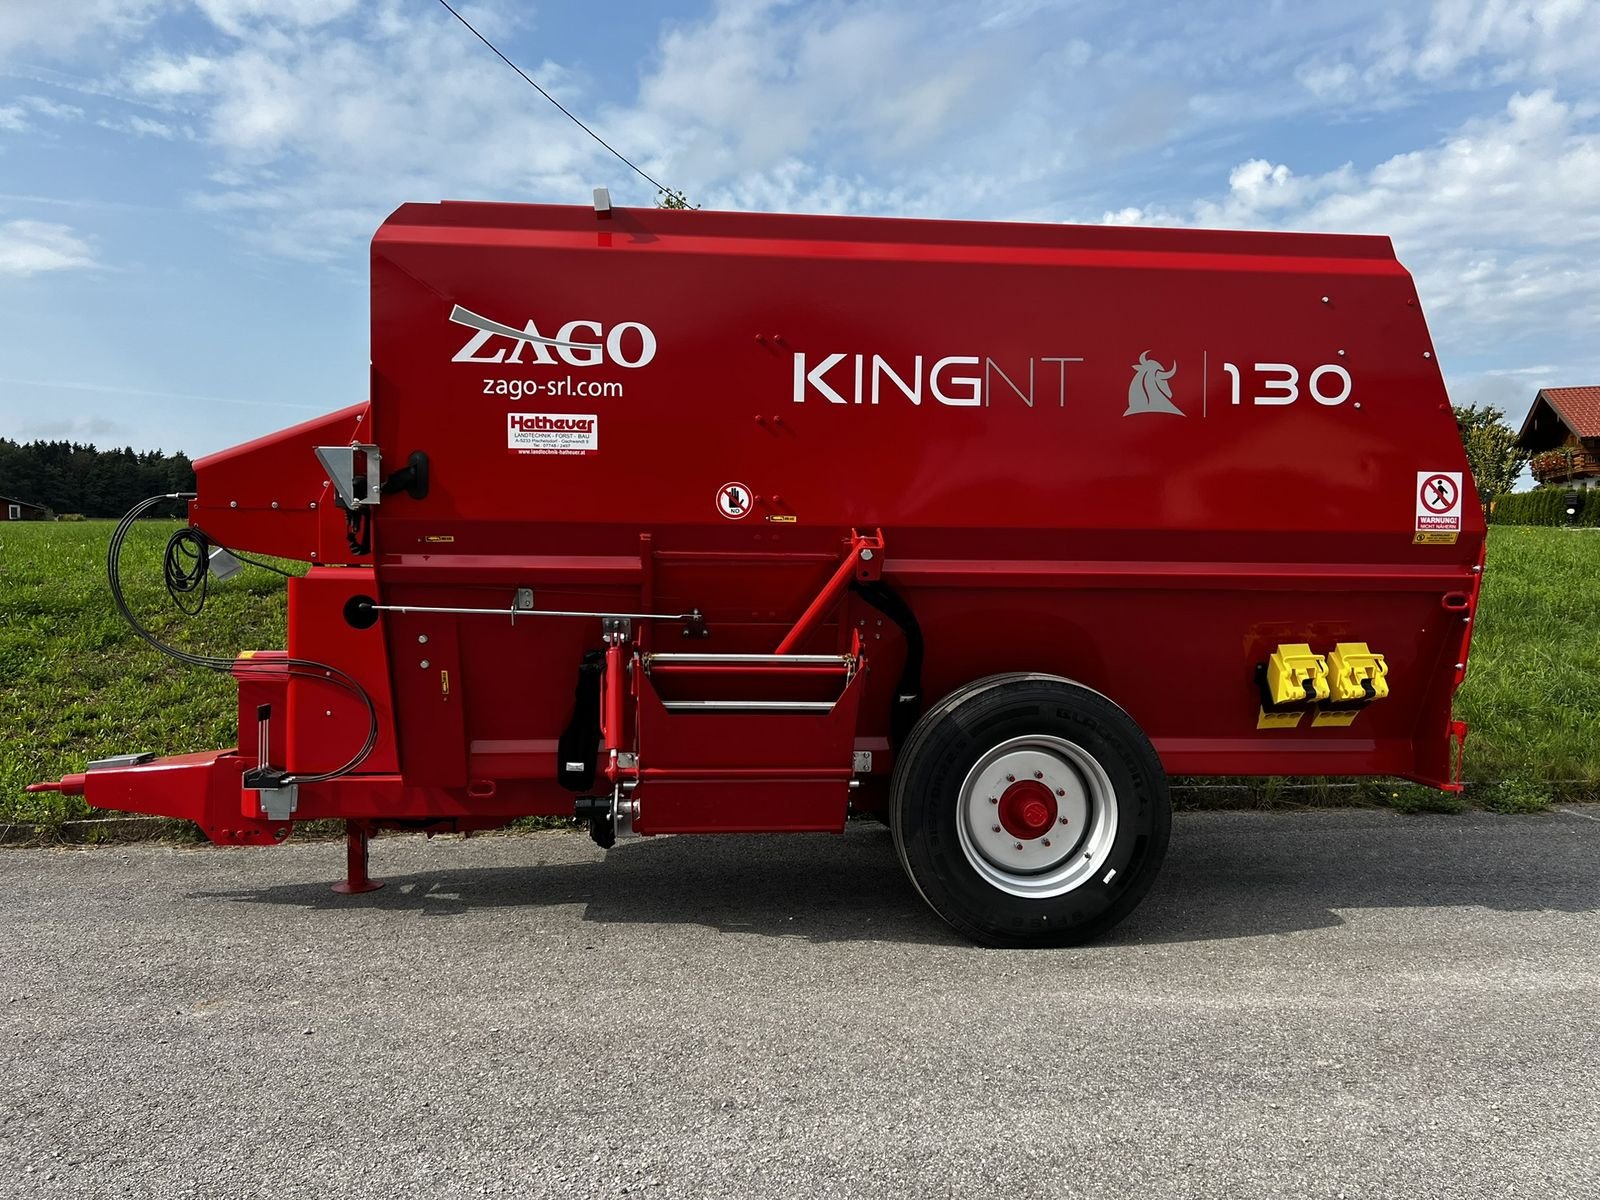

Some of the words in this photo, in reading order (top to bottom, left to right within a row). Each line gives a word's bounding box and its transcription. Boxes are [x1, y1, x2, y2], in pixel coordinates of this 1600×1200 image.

[449, 304, 657, 368] ZAGO
[482, 375, 624, 400] zago-srl.com
[1223, 362, 1352, 406] 130
[510, 415, 595, 433] Hatheuer
